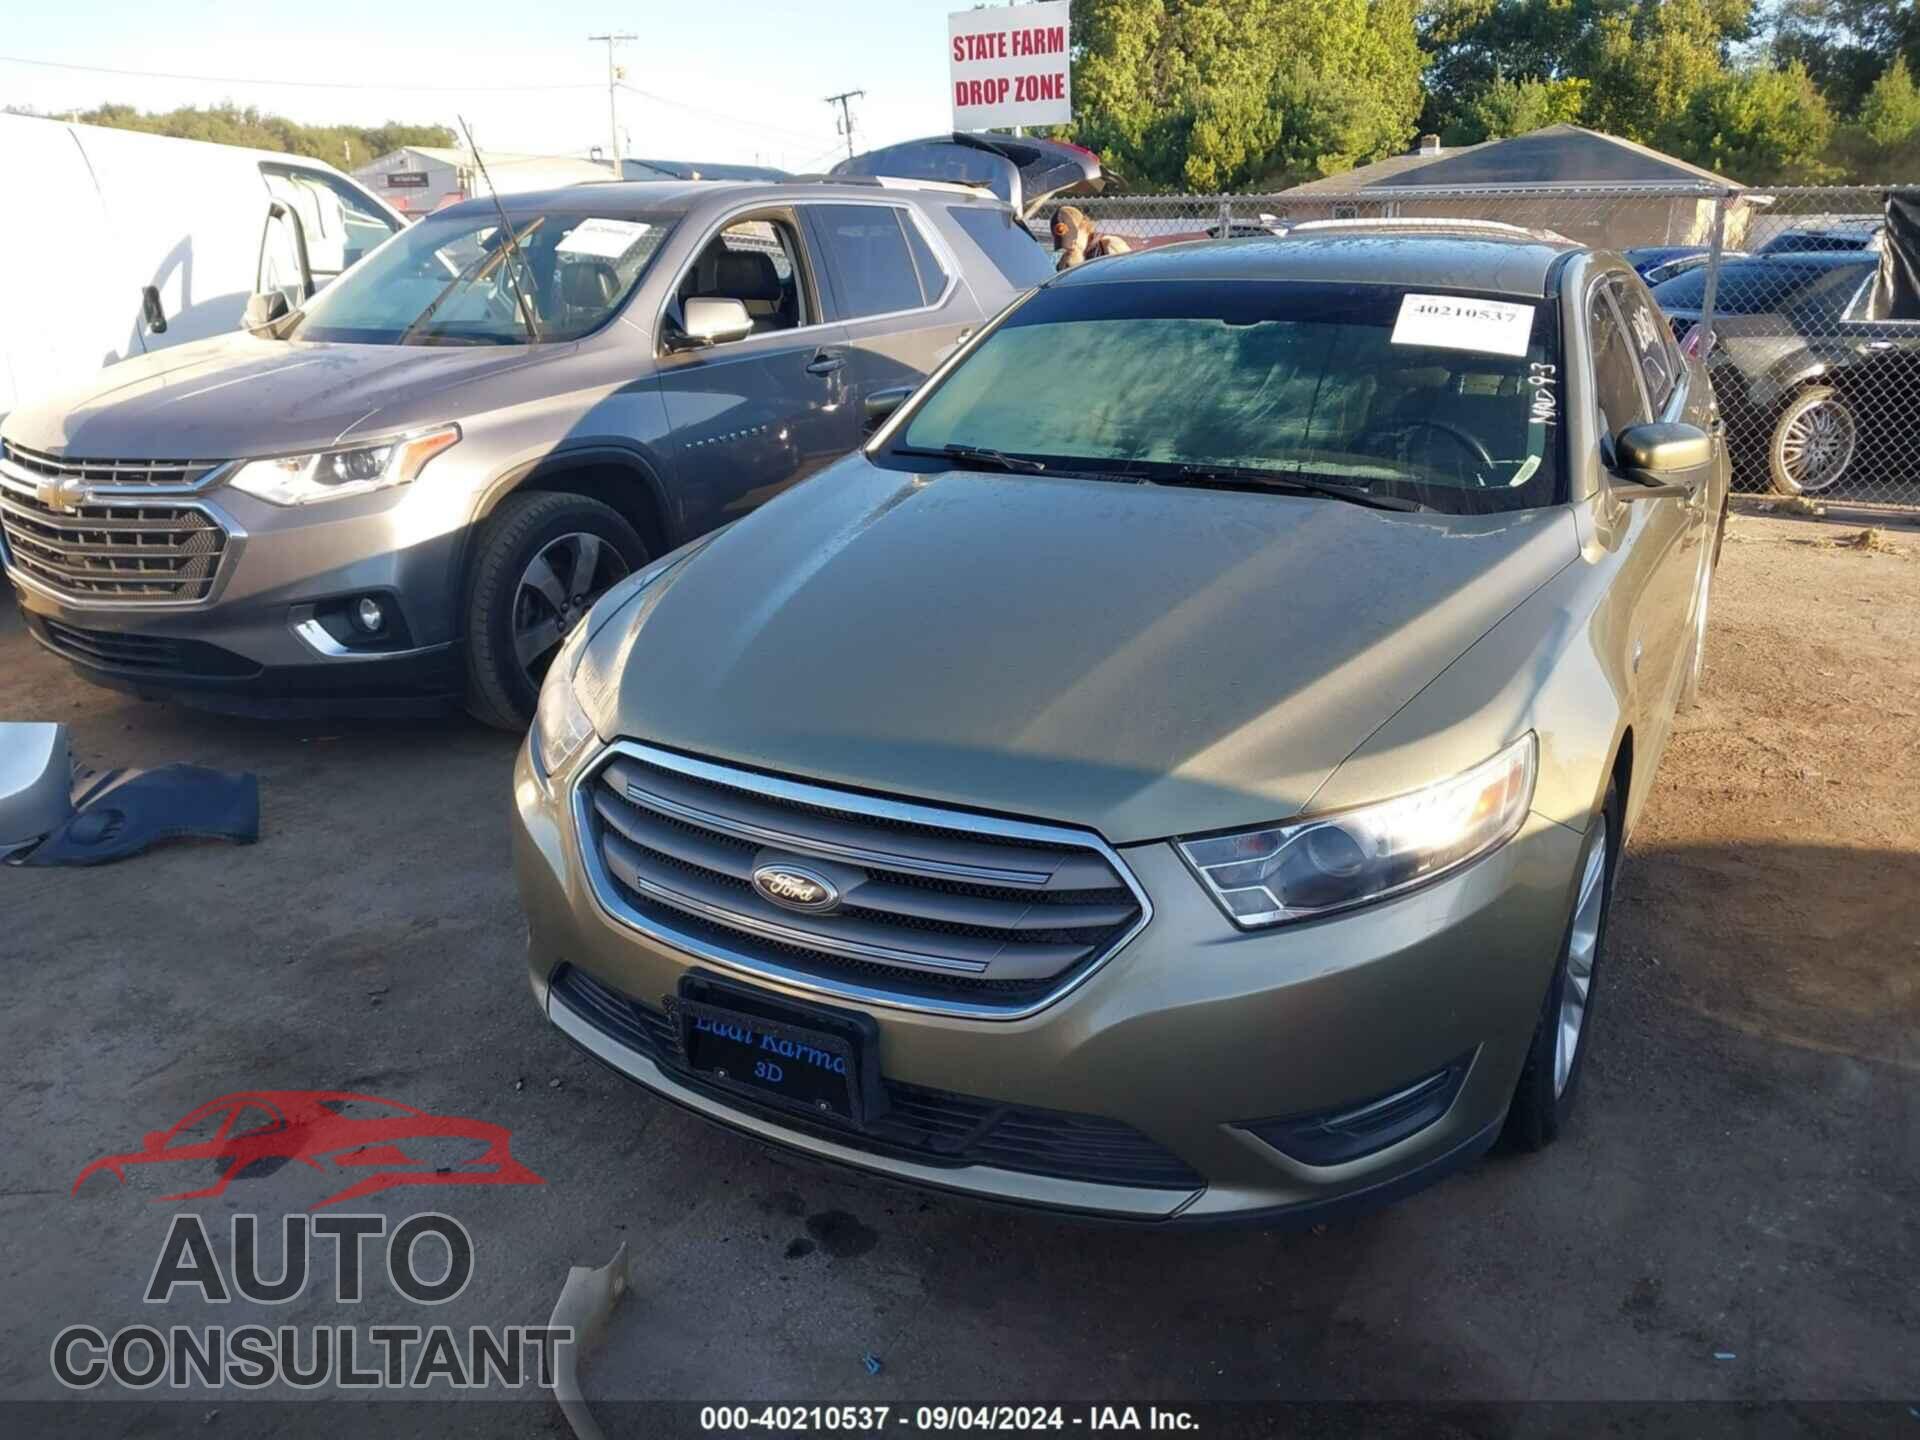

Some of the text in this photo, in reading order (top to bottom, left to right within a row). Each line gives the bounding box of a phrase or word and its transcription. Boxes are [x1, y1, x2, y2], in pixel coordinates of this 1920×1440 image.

[953, 26, 1064, 62] STATE FARM
[955, 73, 1065, 106] DROP ZONE
[1413, 303, 1518, 323] 40210537
[764, 873, 817, 902] Ford
[760, 1034, 849, 1075] Karma
[754, 1061, 784, 1083] 3D
